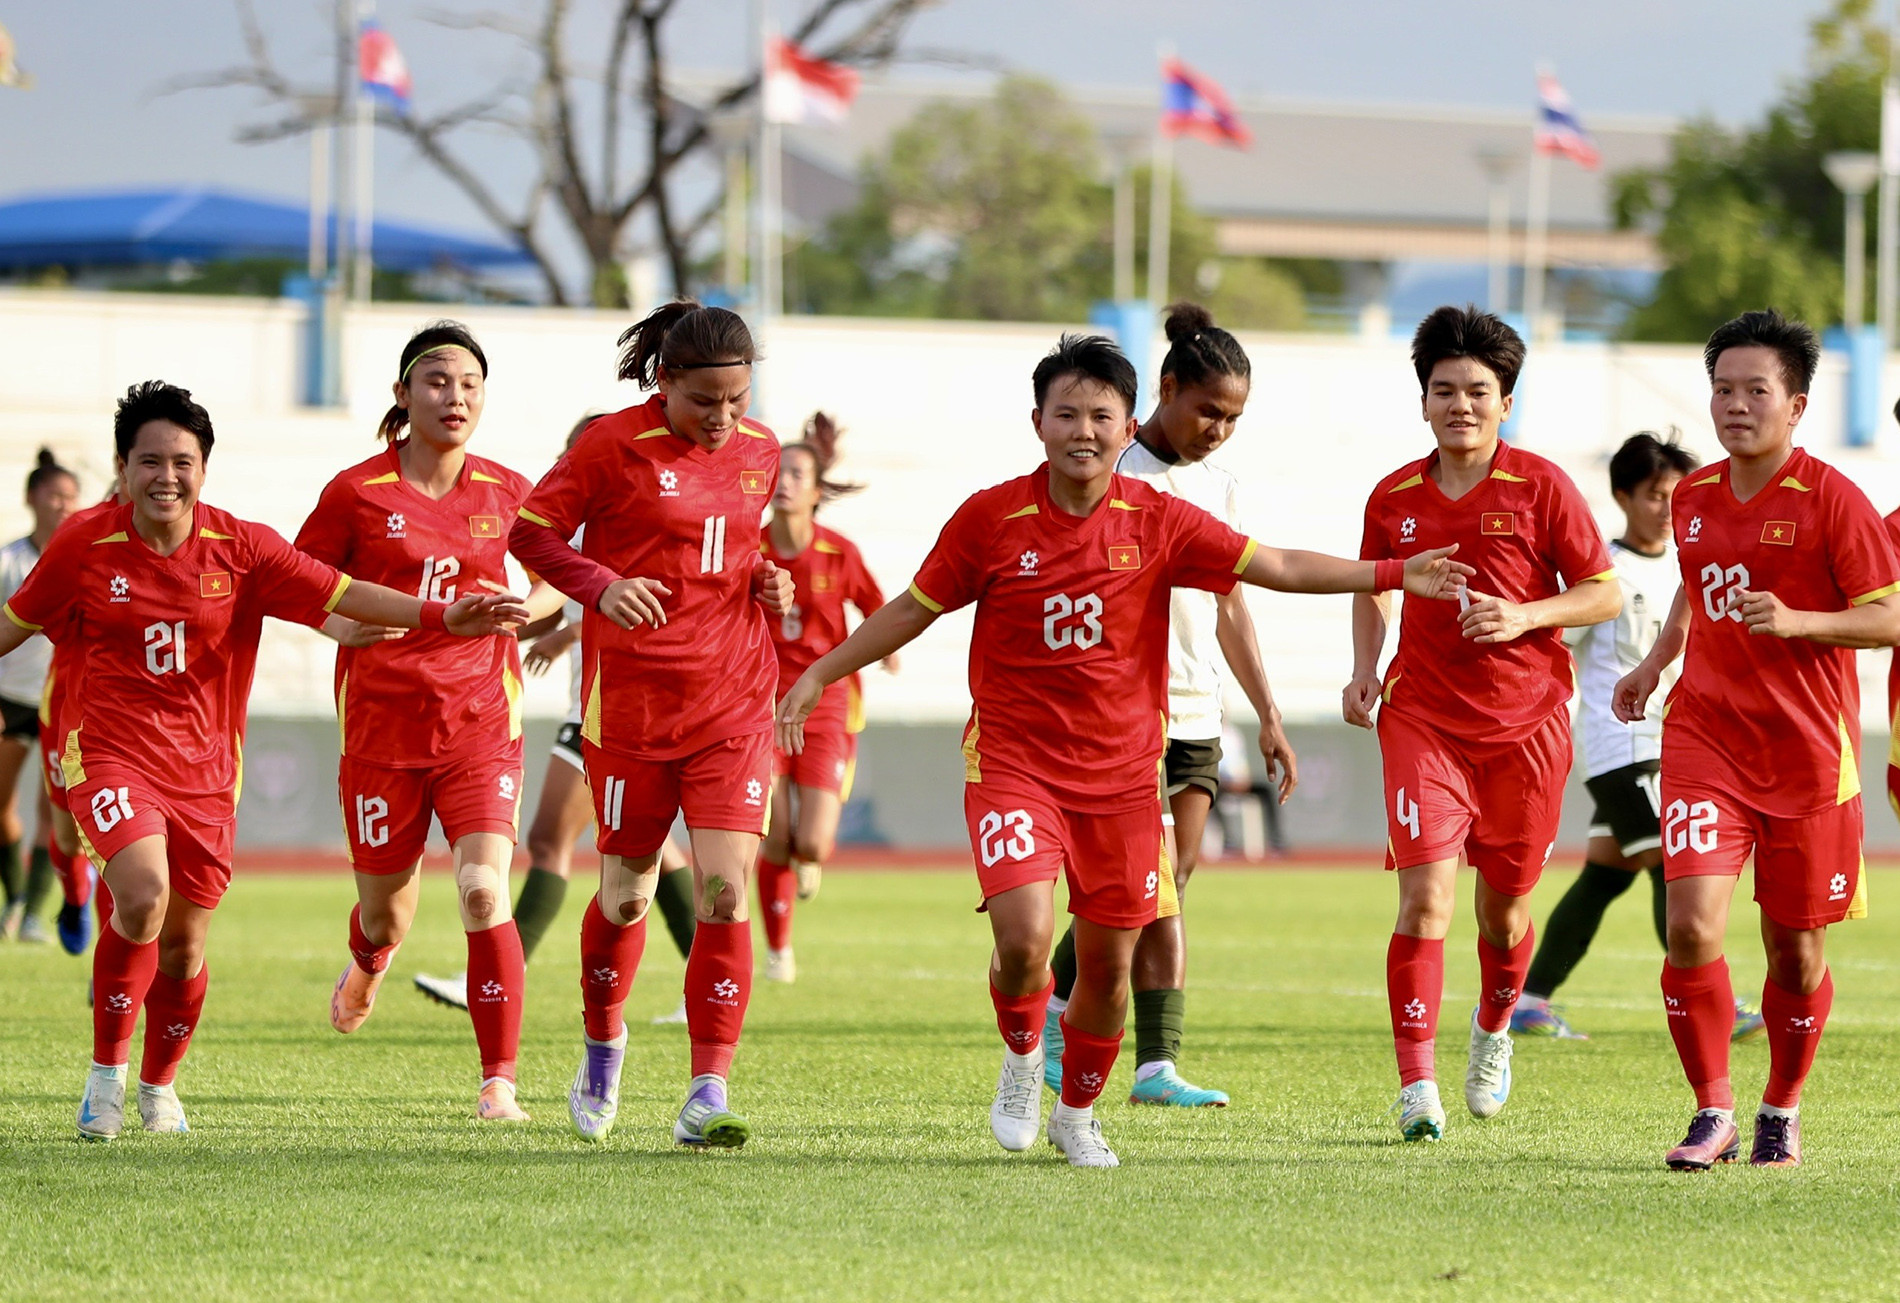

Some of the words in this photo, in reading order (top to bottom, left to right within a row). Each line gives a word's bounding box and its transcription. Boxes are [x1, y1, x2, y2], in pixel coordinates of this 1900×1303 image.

[700, 515, 726, 575] 11
[418, 555, 460, 604] 12
[144, 620, 186, 676] 21
[1043, 592, 1104, 651] 23
[91, 786, 135, 833] 21
[355, 793, 390, 848] 12
[604, 775, 626, 832] 11
[1396, 786, 1421, 841] 4
[1665, 798, 1719, 859] 22
[979, 808, 1036, 869] 23
